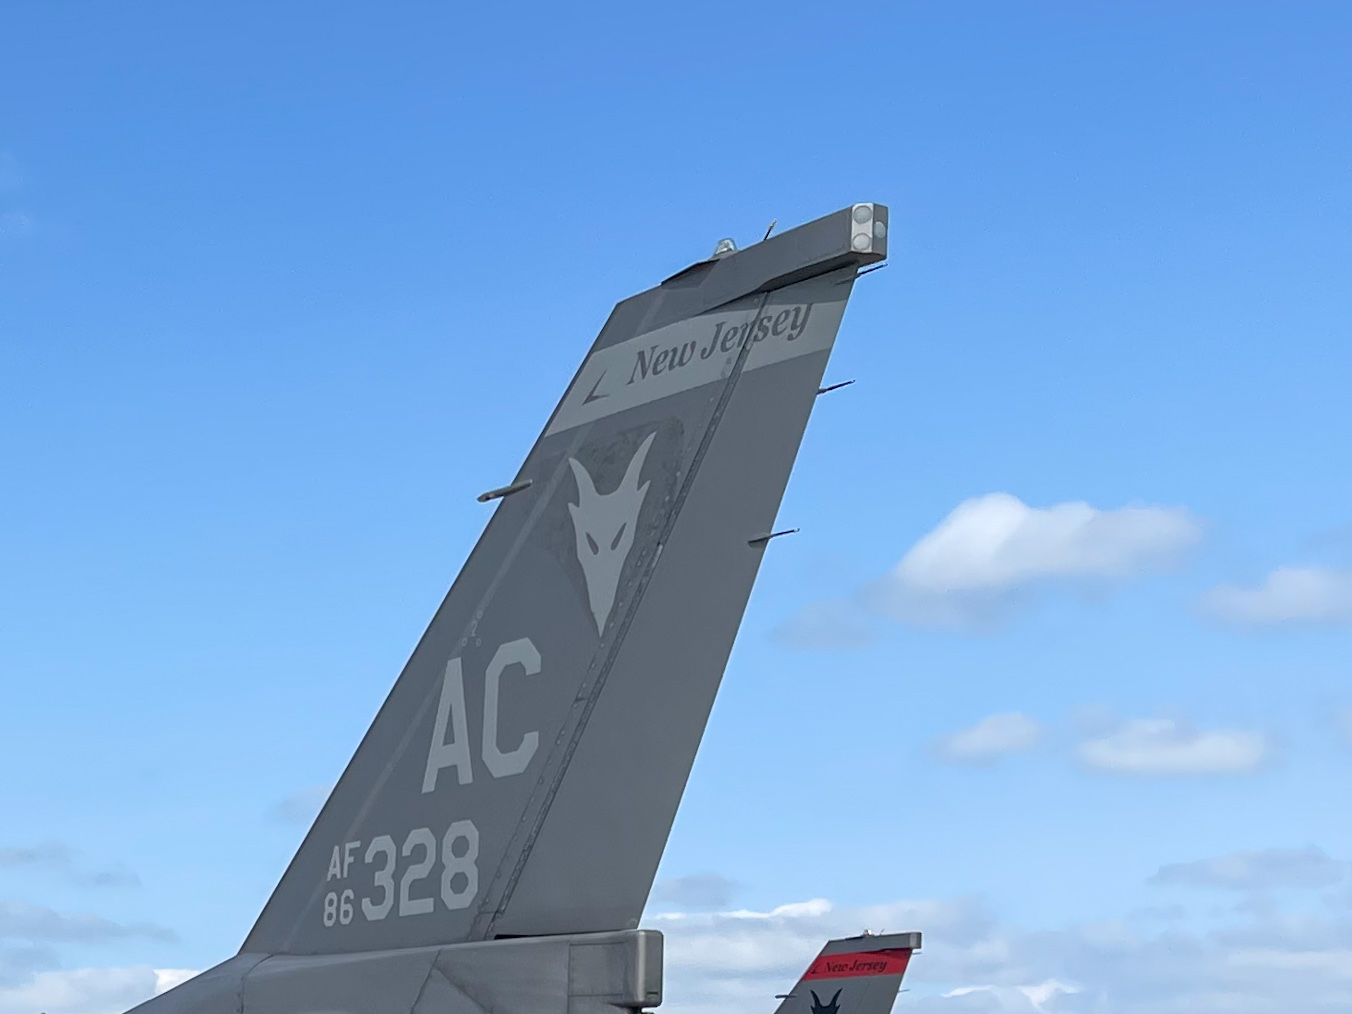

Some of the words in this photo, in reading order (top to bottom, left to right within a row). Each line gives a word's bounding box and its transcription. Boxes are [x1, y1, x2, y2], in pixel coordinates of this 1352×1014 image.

[626, 341, 697, 385] New
[701, 303, 814, 360] Jersey
[421, 637, 541, 794] AC
[327, 840, 361, 881] AF
[361, 819, 479, 921] 328
[323, 889, 354, 927] 86
[826, 961, 848, 973] New
[849, 960, 887, 973] Jersey
